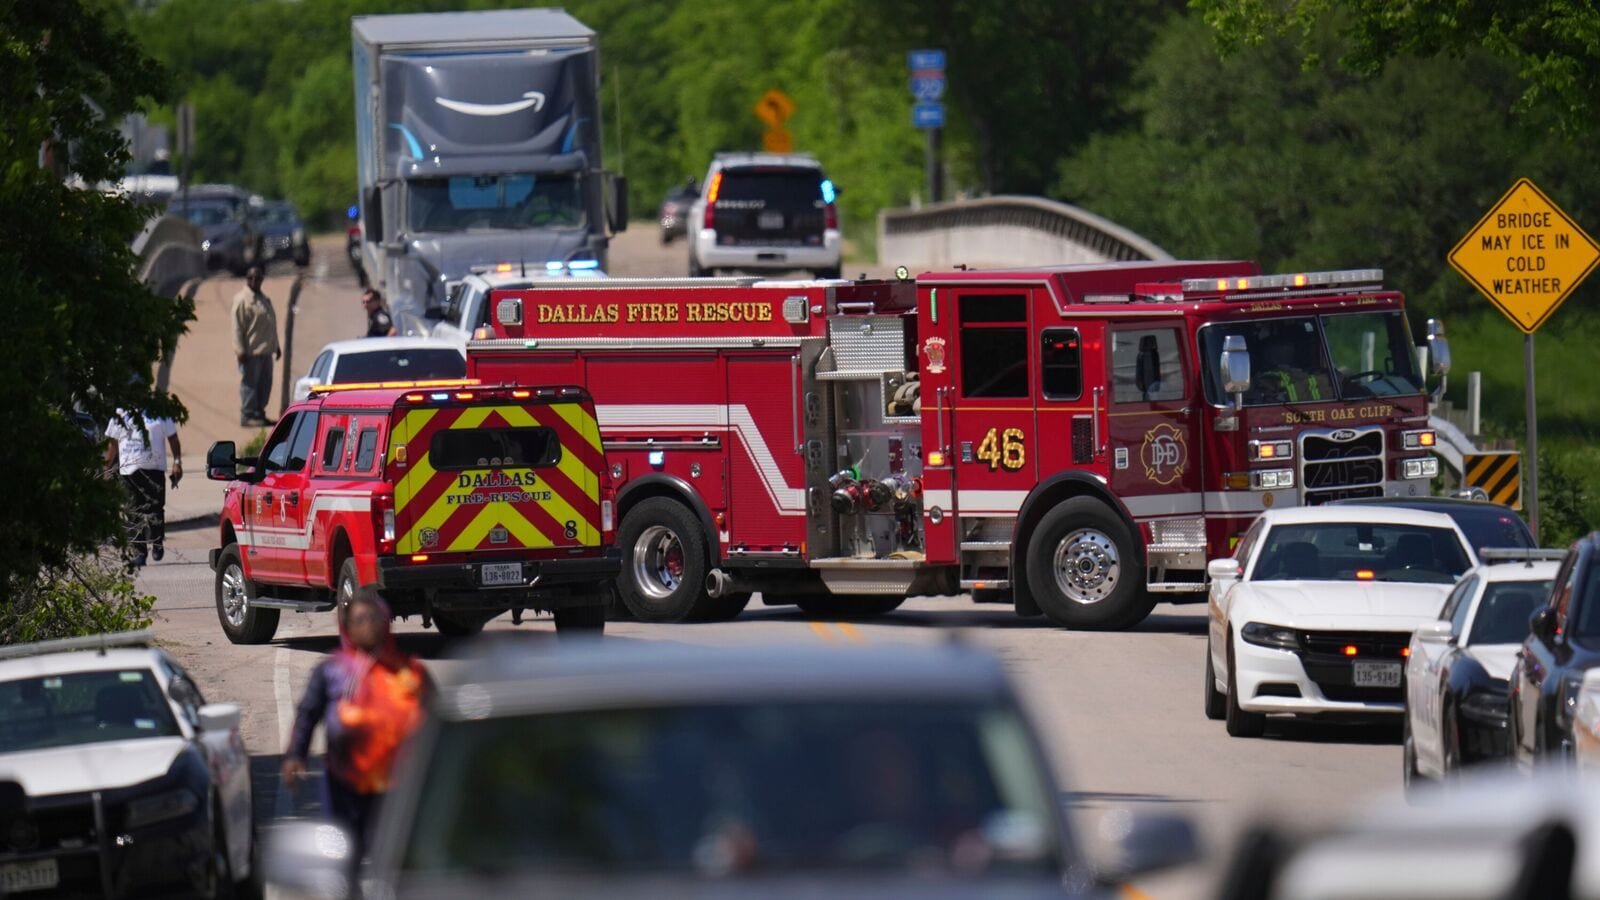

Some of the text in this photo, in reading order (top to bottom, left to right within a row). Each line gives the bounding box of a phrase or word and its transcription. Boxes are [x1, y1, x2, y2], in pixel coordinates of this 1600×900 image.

[1497, 212, 1552, 228] BRIDGE
[1482, 233, 1570, 250] MAY ICE IN
[1506, 256, 1546, 272] COLD
[1493, 278, 1561, 294] WEATHER
[537, 302, 772, 323] DALLAS FIRE RESCUE
[1331, 407, 1355, 420] OAK
[1360, 405, 1392, 417] CLIFF
[976, 427, 1025, 471] 46
[458, 471, 537, 488] DALLAS
[447, 491, 552, 505] FIRE-RESCUE
[564, 520, 578, 540] 8
